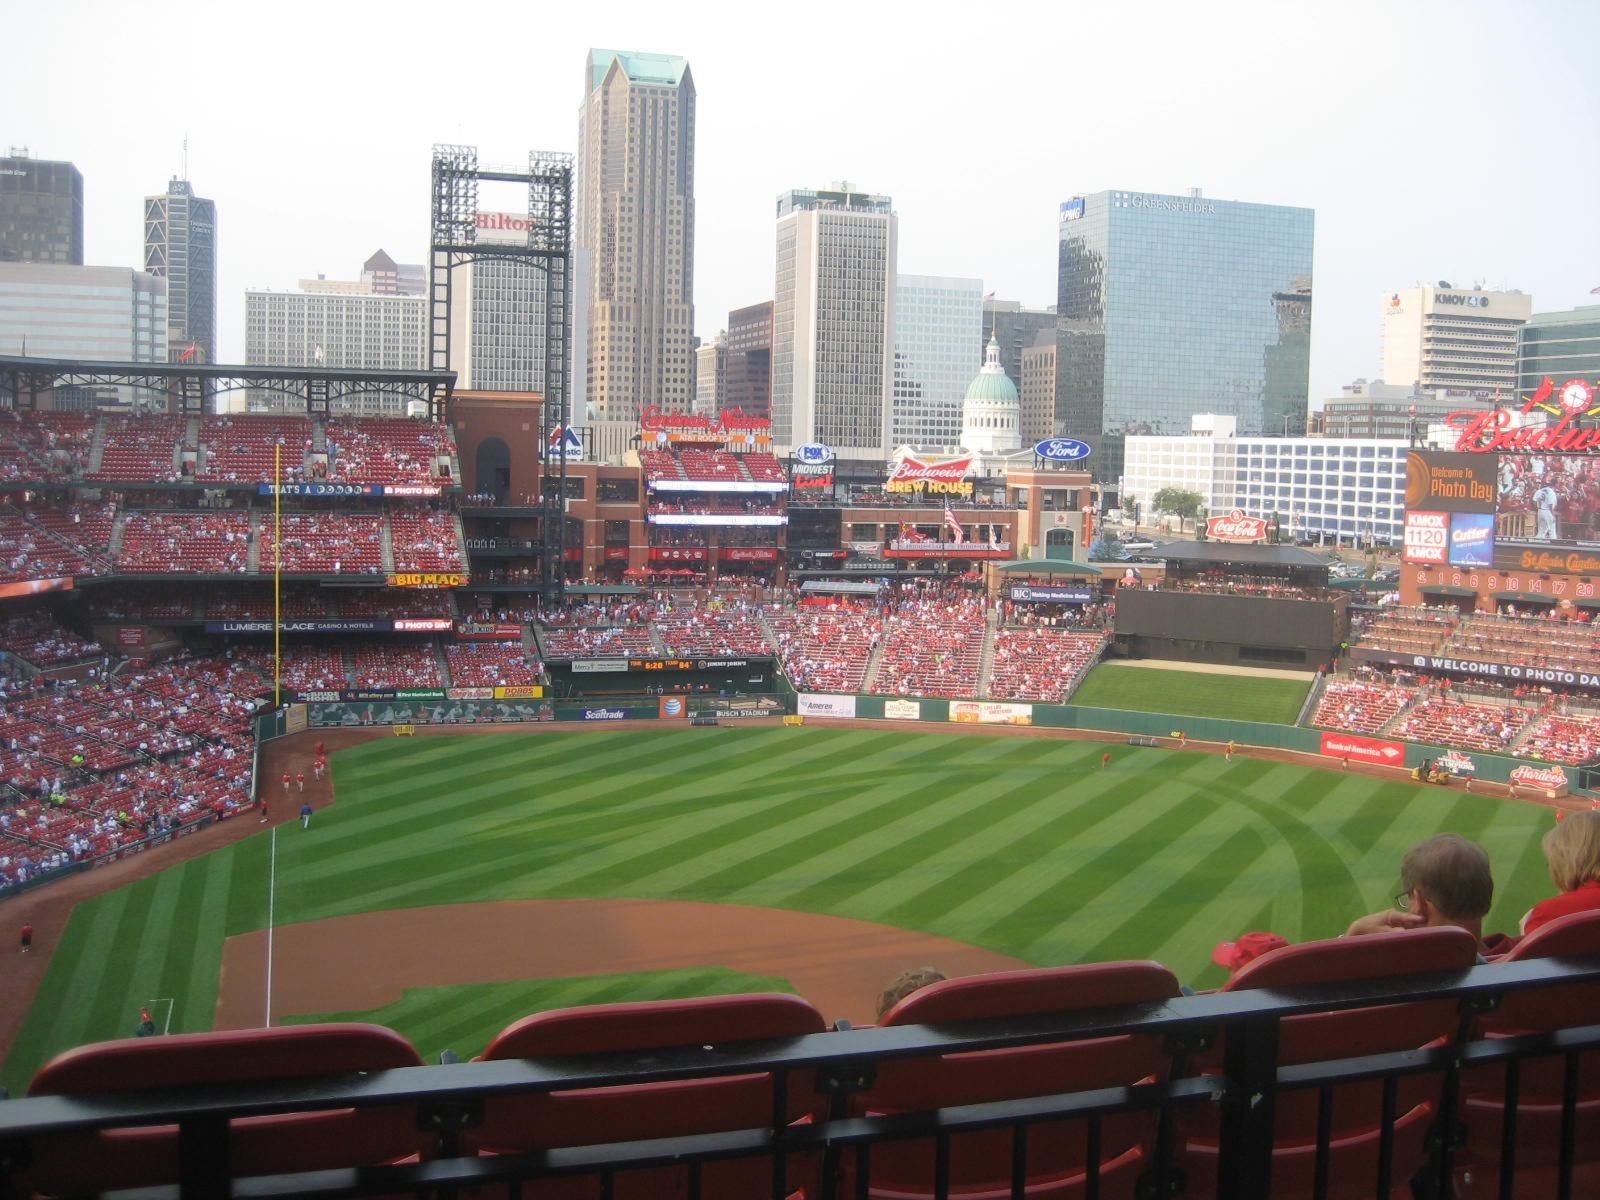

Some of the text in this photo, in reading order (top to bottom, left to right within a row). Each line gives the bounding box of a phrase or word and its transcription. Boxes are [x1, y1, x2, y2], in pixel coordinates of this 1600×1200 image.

[1132, 196, 1215, 214] GREENSFELDER
[476, 212, 534, 231] Hilton
[1060, 208, 1081, 222] KPMG
[1434, 294, 1466, 305] KMOV
[641, 405, 770, 433] Cardinals Nation
[803, 446, 823, 457] FOX
[1046, 440, 1080, 456] Ford
[792, 463, 834, 474] MIDWEST
[887, 462, 968, 478] Budweiser
[1431, 467, 1463, 478] Welcome
[305, 486, 311, 494] A
[394, 486, 441, 495] PHOTO DAY
[887, 480, 974, 494] BREW HOUSE
[1431, 479, 1493, 503] Photo Day
[1408, 513, 1445, 528] KMOX
[1213, 520, 1259, 537] Coca-Cola
[1407, 529, 1443, 544] 1120
[1406, 545, 1443, 560] KMOX
[395, 574, 459, 585] BIG MAC
[1452, 573, 1461, 586] 2
[1469, 574, 1479, 587] 6
[1488, 575, 1497, 589] 9
[1528, 579, 1542, 593] 14
[1013, 589, 1029, 598] BJC
[1552, 580, 1567, 595] 17
[1576, 582, 1594, 597] 20
[277, 622, 315, 631] PLACE
[434, 622, 451, 630] DAY
[1431, 657, 1499, 675] WELCOME
[1503, 666, 1521, 677] TO
[1525, 668, 1575, 684] PHOTO
[504, 687, 534, 695] DOBBS
[740, 709, 769, 717] STADIUM
[807, 702, 833, 710] Ameren
[585, 708, 624, 720] Scottrade
[1326, 740, 1344, 750] Bank
[1352, 745, 1381, 756] America
